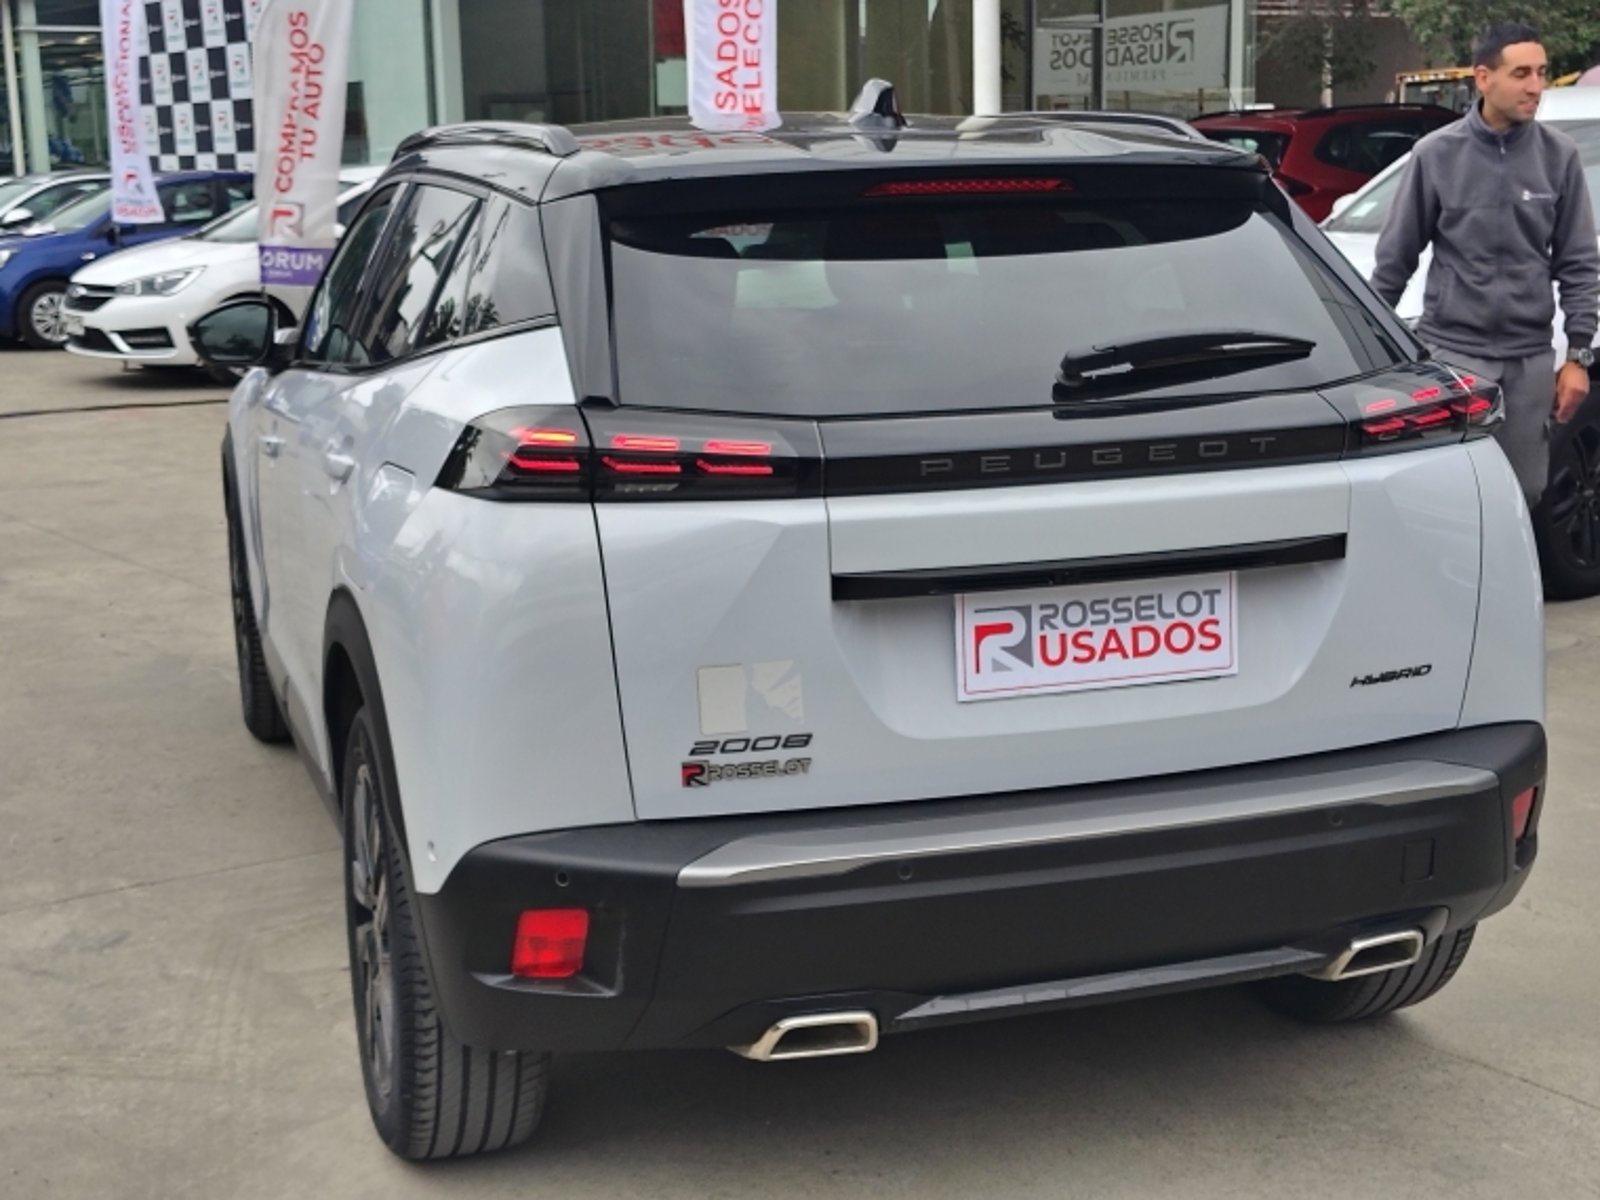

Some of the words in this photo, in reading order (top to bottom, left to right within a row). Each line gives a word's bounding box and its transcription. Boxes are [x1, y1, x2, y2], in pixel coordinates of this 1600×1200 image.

[303, 43, 325, 120] AUTO
[300, 128, 318, 162] TU
[920, 437, 1276, 476] PEUGEOT
[1038, 589, 1222, 631] ROSSELOT
[1038, 618, 1222, 668] USADOS
[1349, 664, 1432, 688] HYBRID
[688, 733, 813, 756] 2008
[709, 757, 812, 783] ROSSELOT
